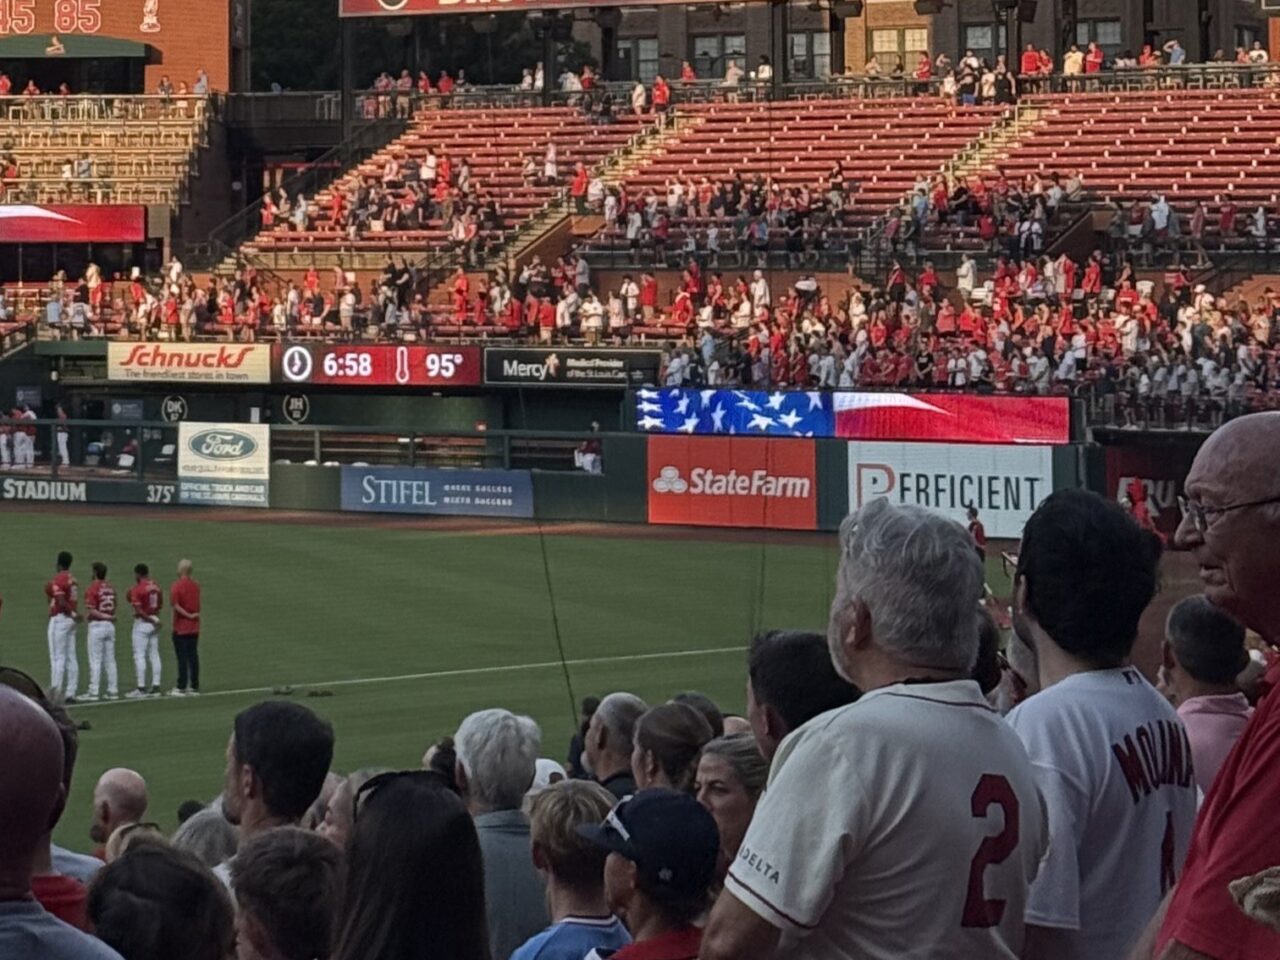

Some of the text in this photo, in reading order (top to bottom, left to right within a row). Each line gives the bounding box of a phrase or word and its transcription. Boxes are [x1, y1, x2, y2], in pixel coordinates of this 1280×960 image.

[120, 344, 256, 368] Schnucks
[324, 353, 372, 377] 6:58
[425, 353, 464, 377] 95°
[503, 360, 547, 380] Mercy
[201, 434, 244, 455] Ford
[3, 478, 87, 502] STADIUM
[362, 475, 437, 506] STIFEL
[856, 463, 1040, 511] PERFICIENT
[961, 773, 1019, 929] 2
